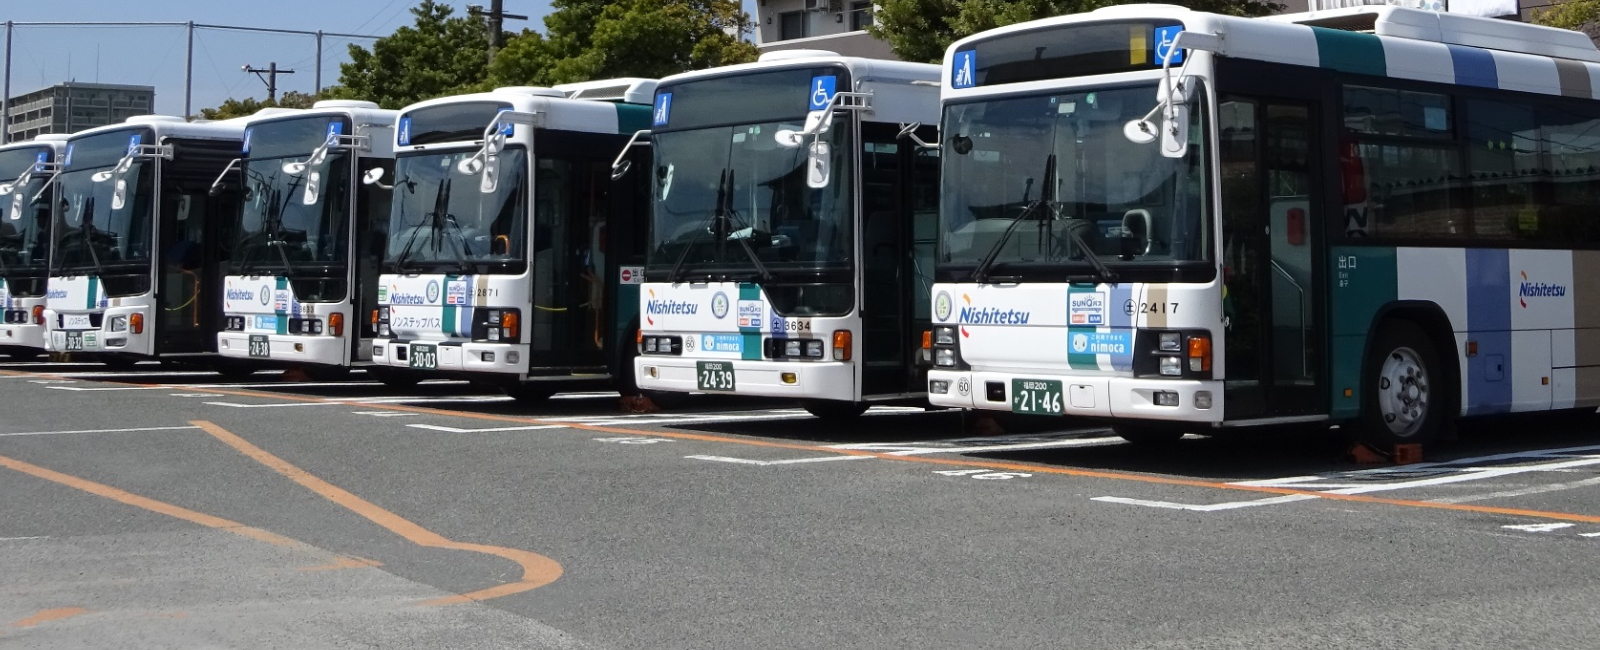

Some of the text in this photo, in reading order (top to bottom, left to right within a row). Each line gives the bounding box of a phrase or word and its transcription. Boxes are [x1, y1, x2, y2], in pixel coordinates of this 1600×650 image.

[1338, 255, 1357, 269] 出口
[226, 288, 255, 301] Nishitetsu
[477, 288, 499, 297] 2871
[1519, 282, 1566, 297] Nishitetsu
[390, 292, 425, 305] Nishitetsu
[646, 300, 699, 315] Nishitetsu
[1140, 302, 1179, 314] 2417
[959, 306, 1031, 325] Nishitetsu
[392, 317, 441, 328] ノンステップバス
[785, 321, 811, 331] 3634
[716, 341, 740, 351] nimoca
[1090, 340, 1125, 353] nimoca
[414, 352, 436, 368] 30-03
[703, 370, 733, 389] 24-39
[959, 383, 969, 392] 60
[1020, 390, 1061, 413] 21-46
